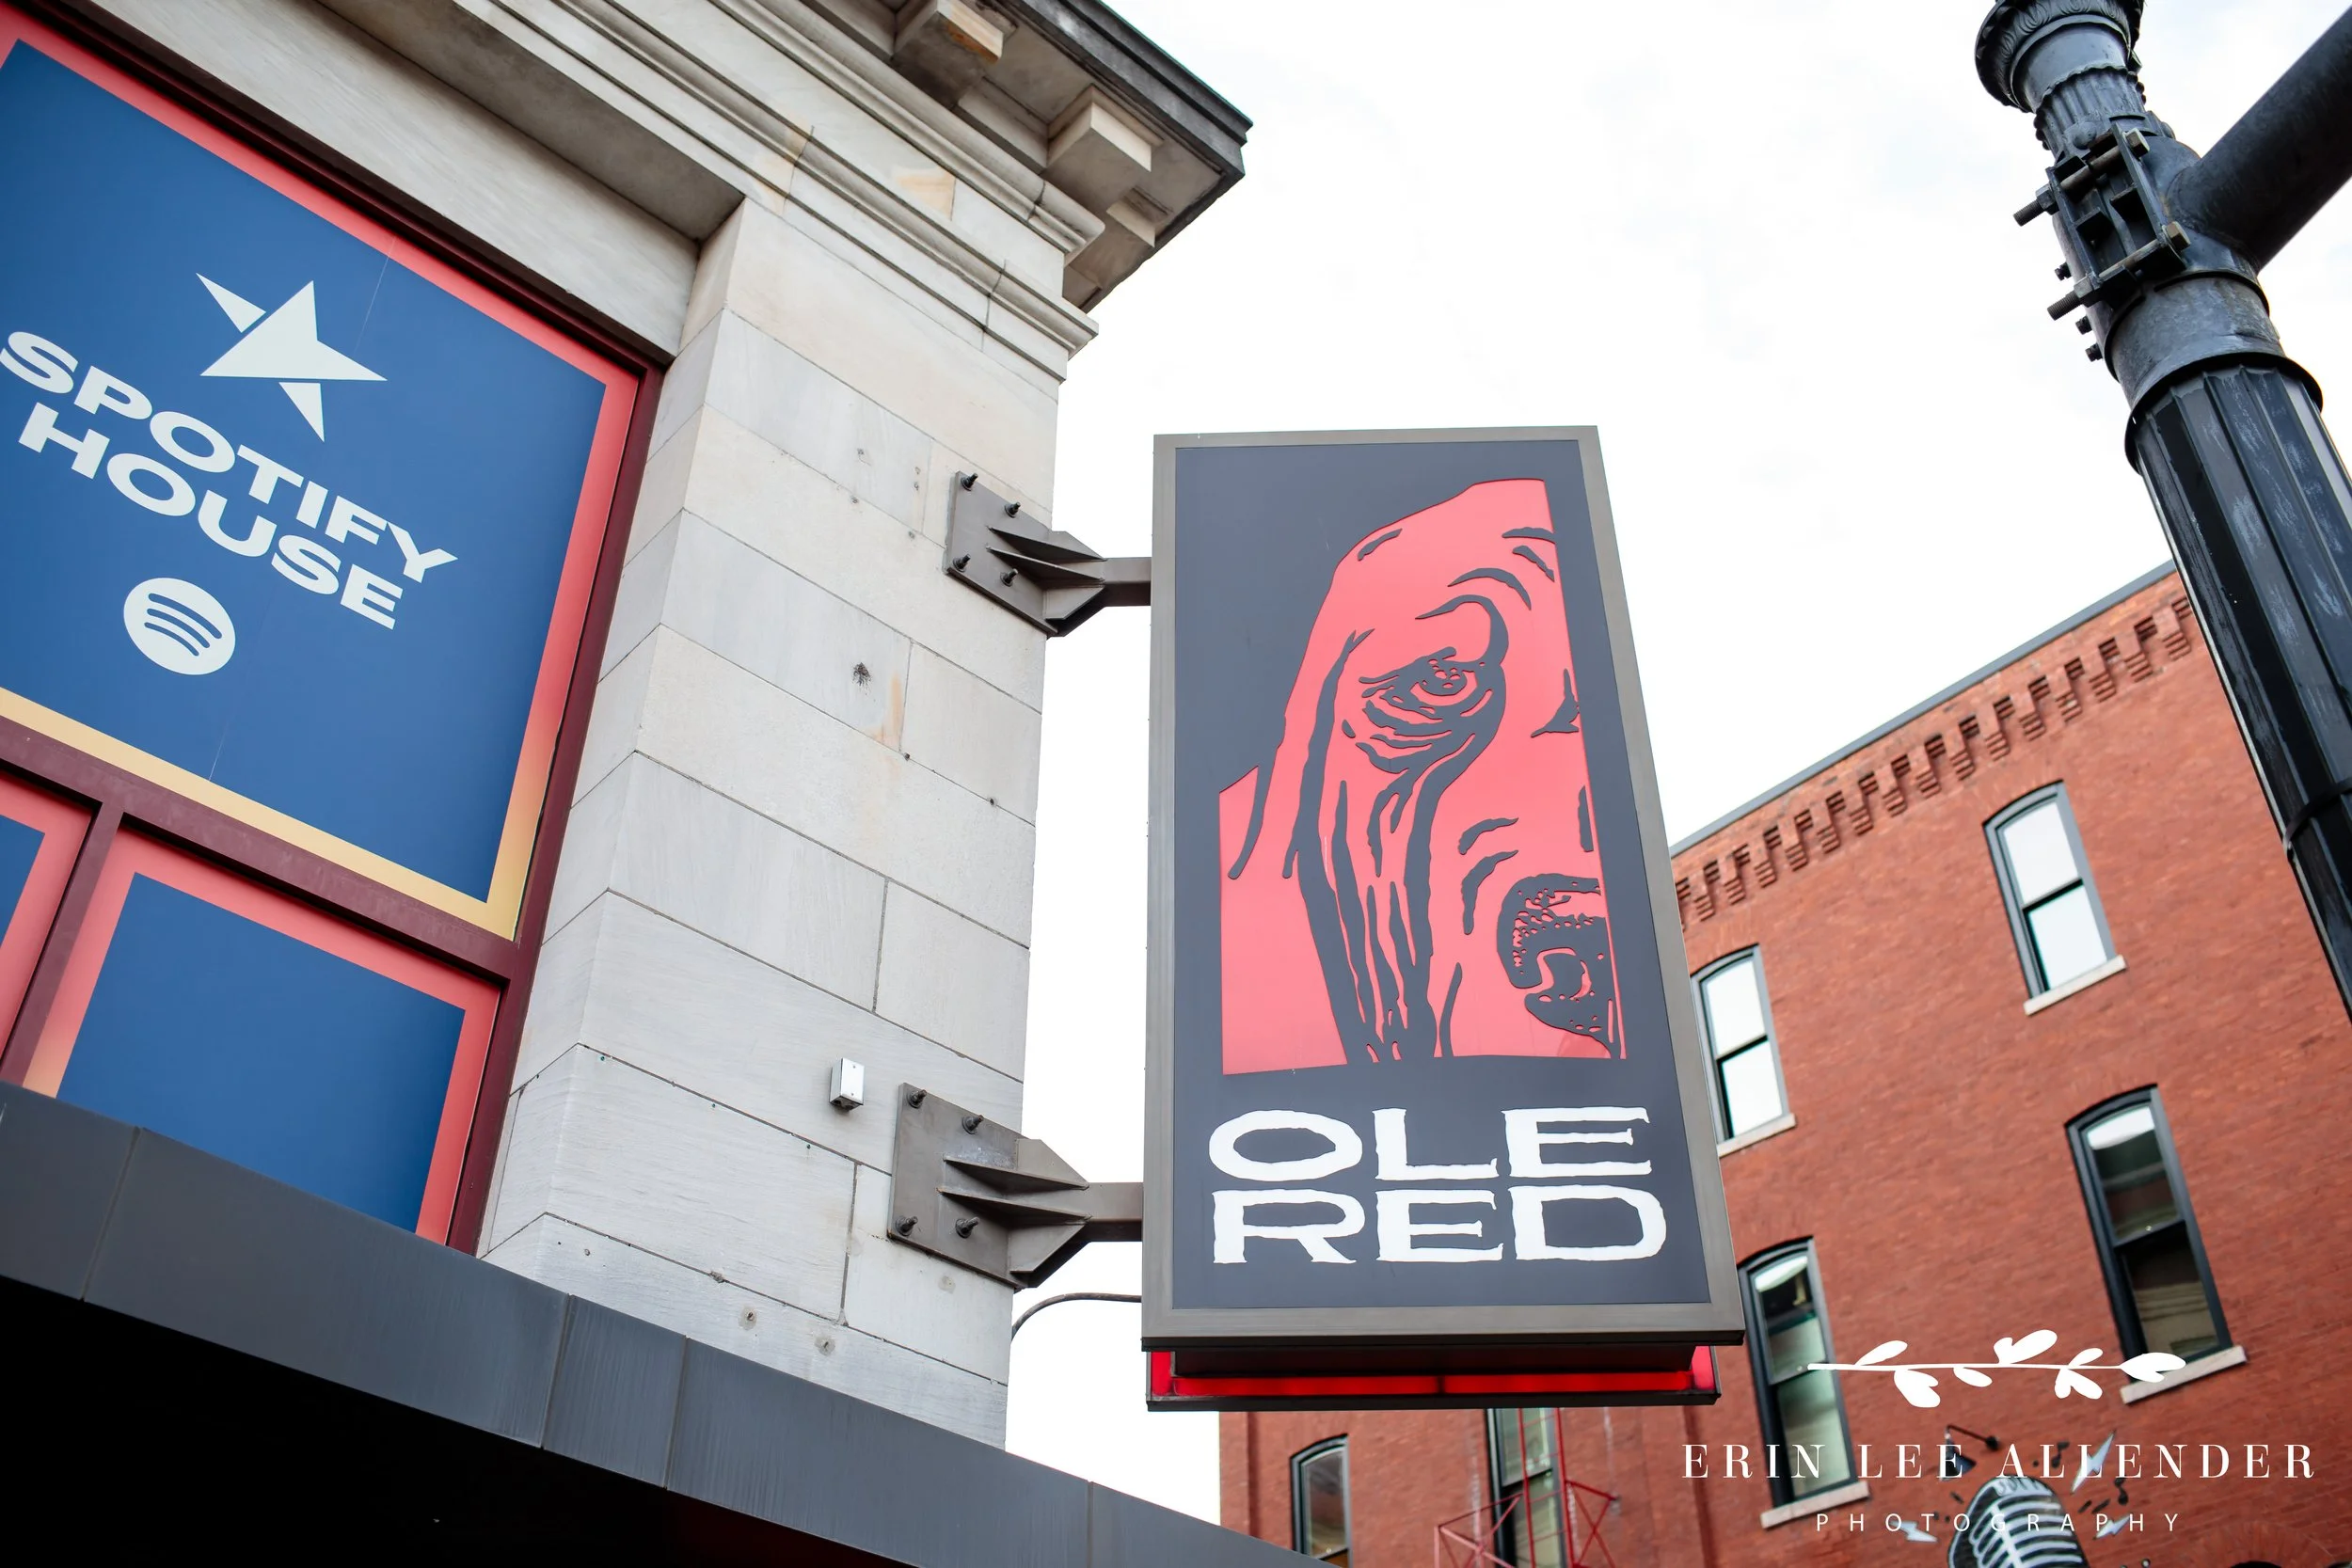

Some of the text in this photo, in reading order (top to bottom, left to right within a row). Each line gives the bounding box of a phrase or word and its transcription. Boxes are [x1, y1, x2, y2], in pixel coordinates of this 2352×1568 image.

[0, 332, 458, 583] SPOTIFY
[19, 403, 404, 630] HOUSE
[1209, 1106, 1652, 1181] OLE
[1212, 1184, 1667, 1264] RED
